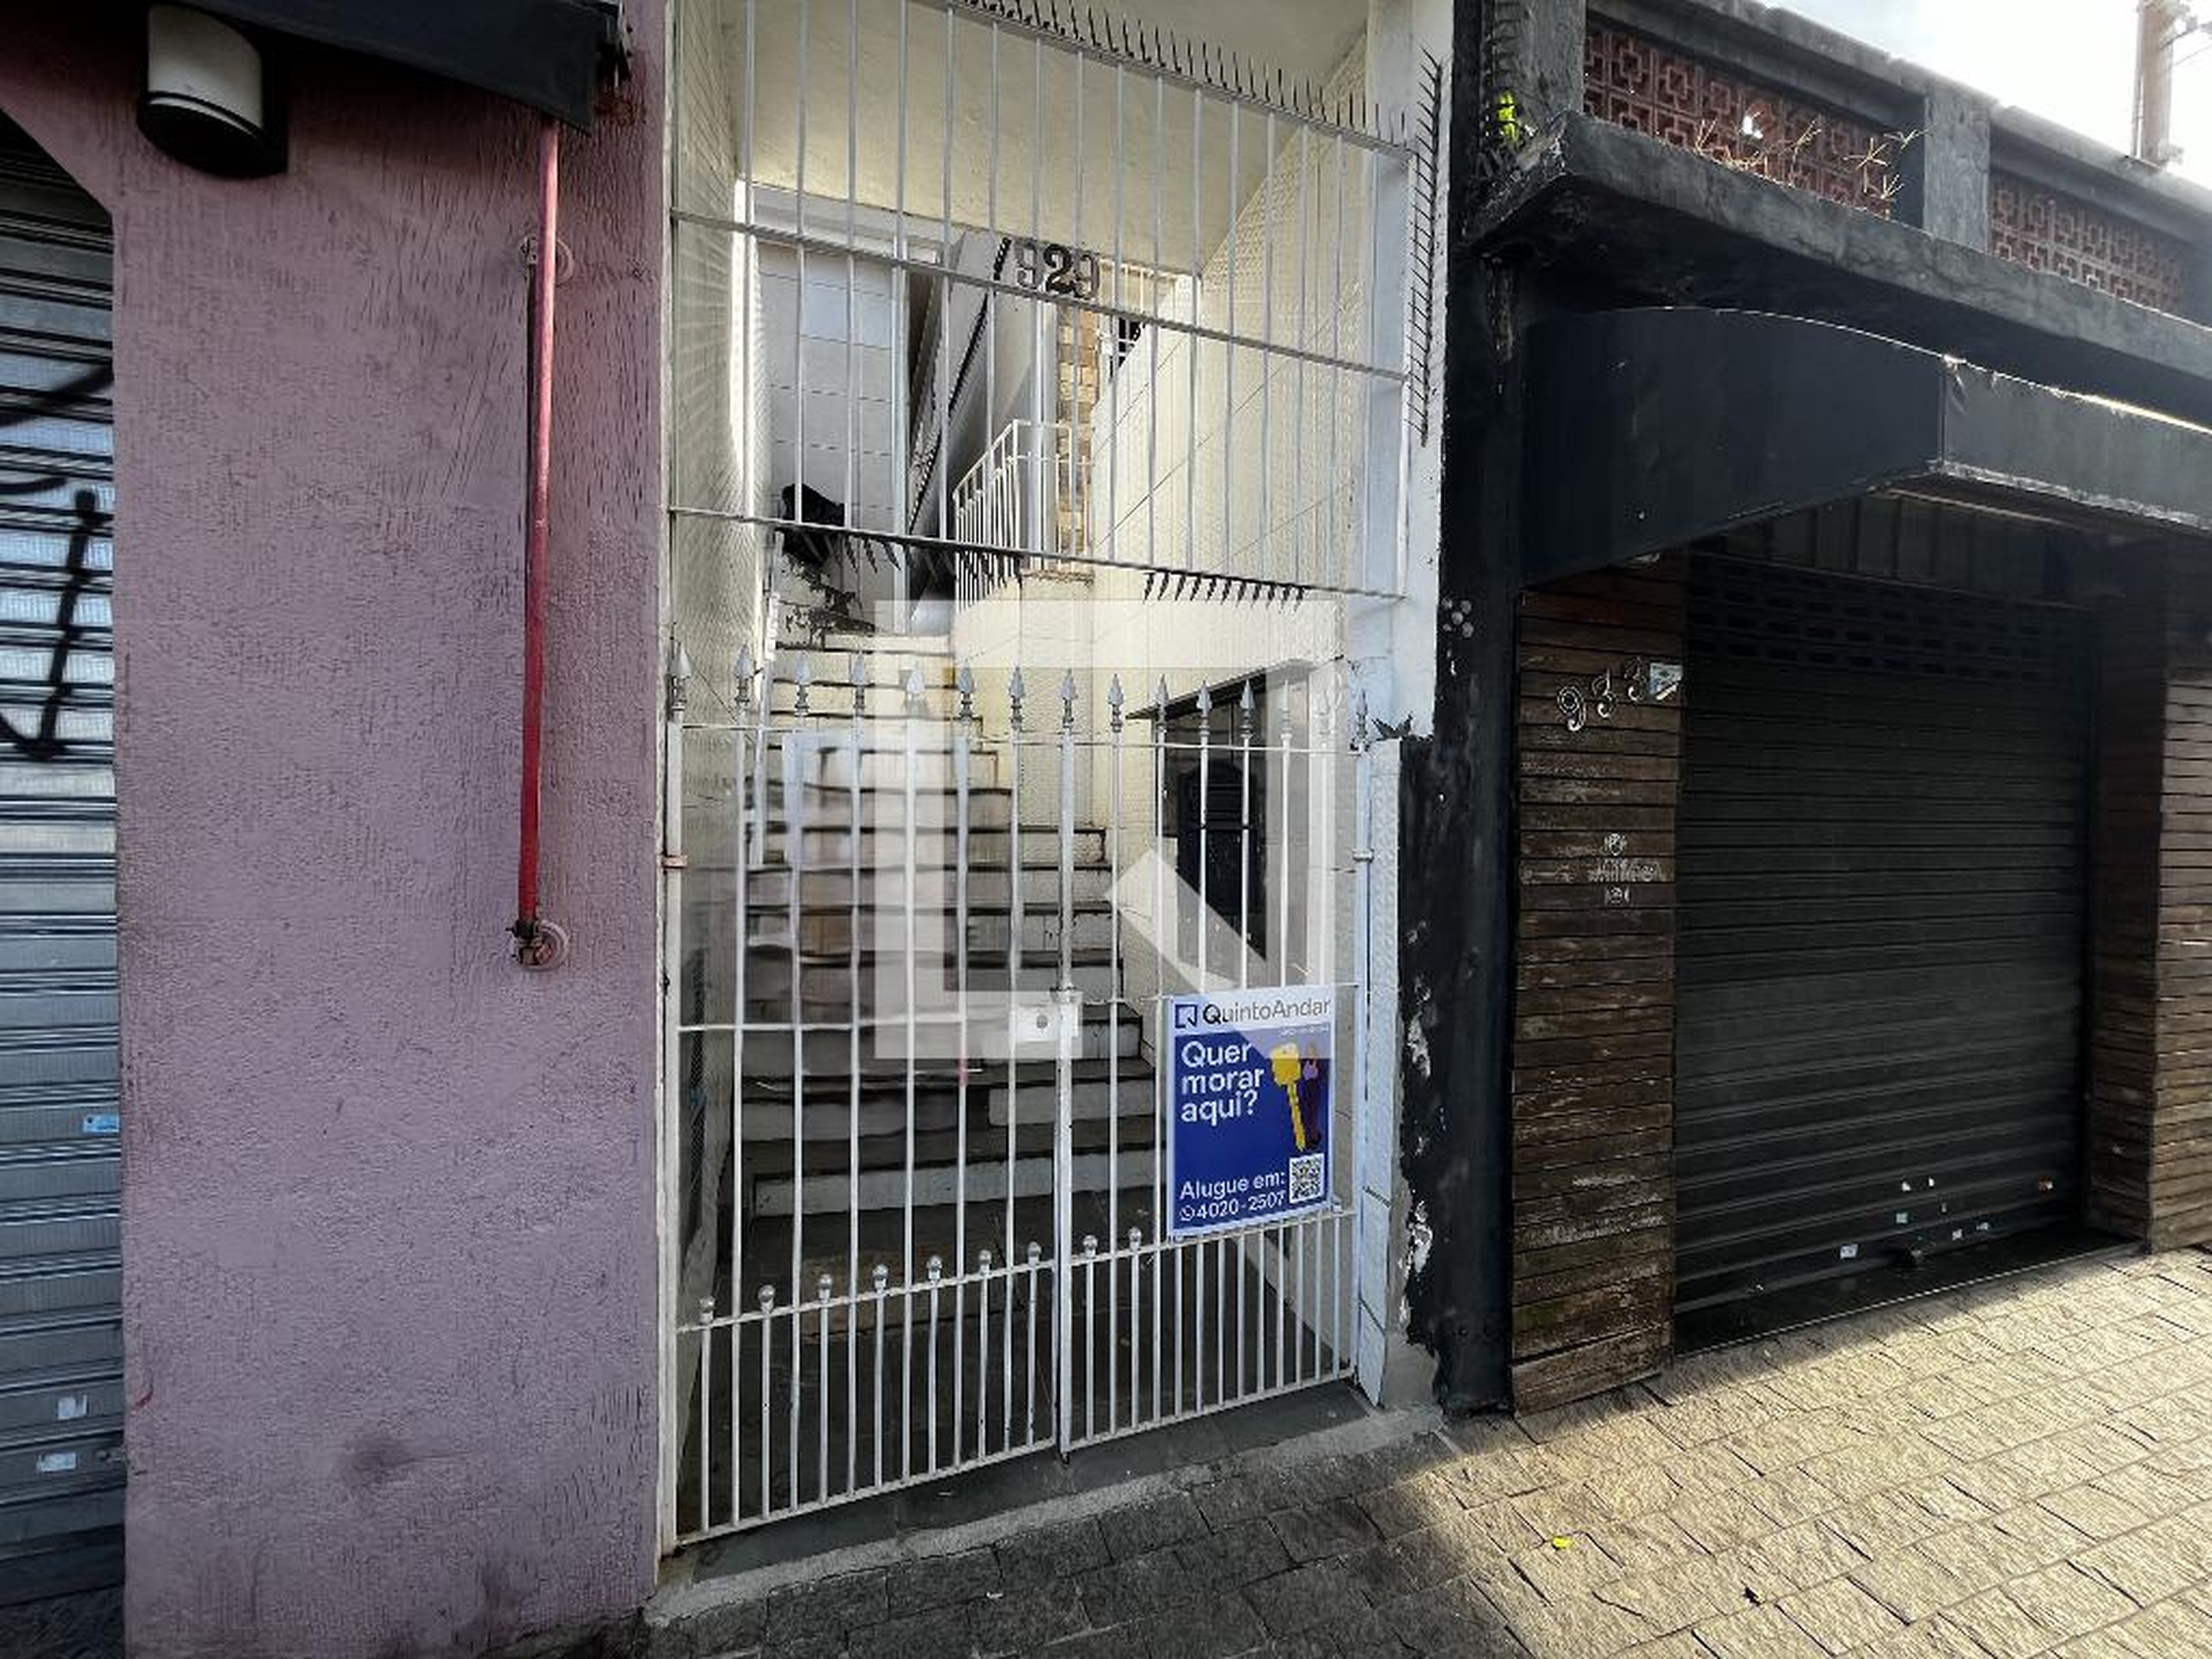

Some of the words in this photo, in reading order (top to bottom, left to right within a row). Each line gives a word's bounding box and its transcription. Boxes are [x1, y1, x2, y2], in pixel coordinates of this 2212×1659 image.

[1015, 238, 1100, 300] 929
[1203, 999, 1331, 1024] QuintoAndar
[1181, 1041, 1252, 1067] Quer
[1182, 1069, 1264, 1094] morar
[1181, 1090, 1257, 1126] aqui?
[1180, 1179, 1249, 1200] Alugue
[1253, 1172, 1285, 1189] em:
